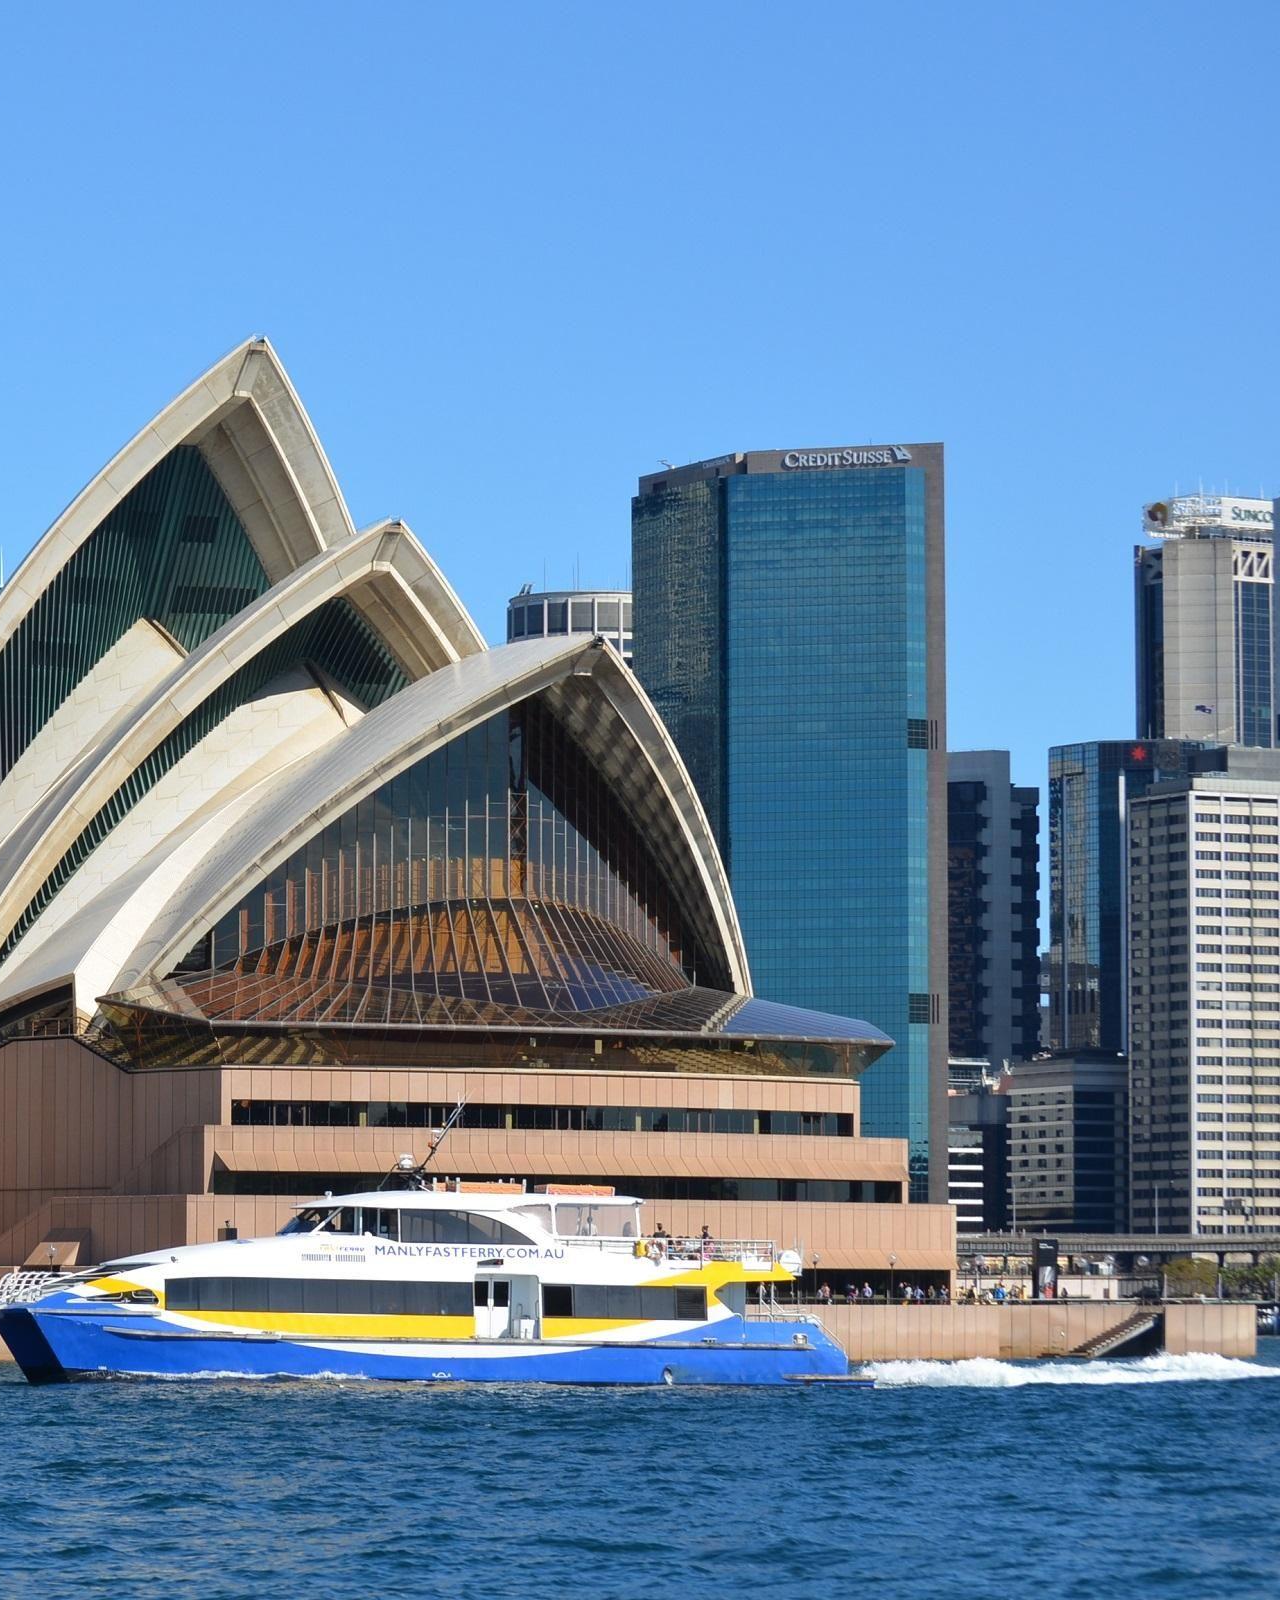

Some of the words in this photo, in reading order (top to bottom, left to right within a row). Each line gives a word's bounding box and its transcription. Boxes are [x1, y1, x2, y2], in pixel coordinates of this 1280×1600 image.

[784, 452, 842, 467] CREDIT
[842, 449, 892, 465] SUISSE
[374, 1245, 565, 1259] MANLYFASTFERRY.COM.AU
